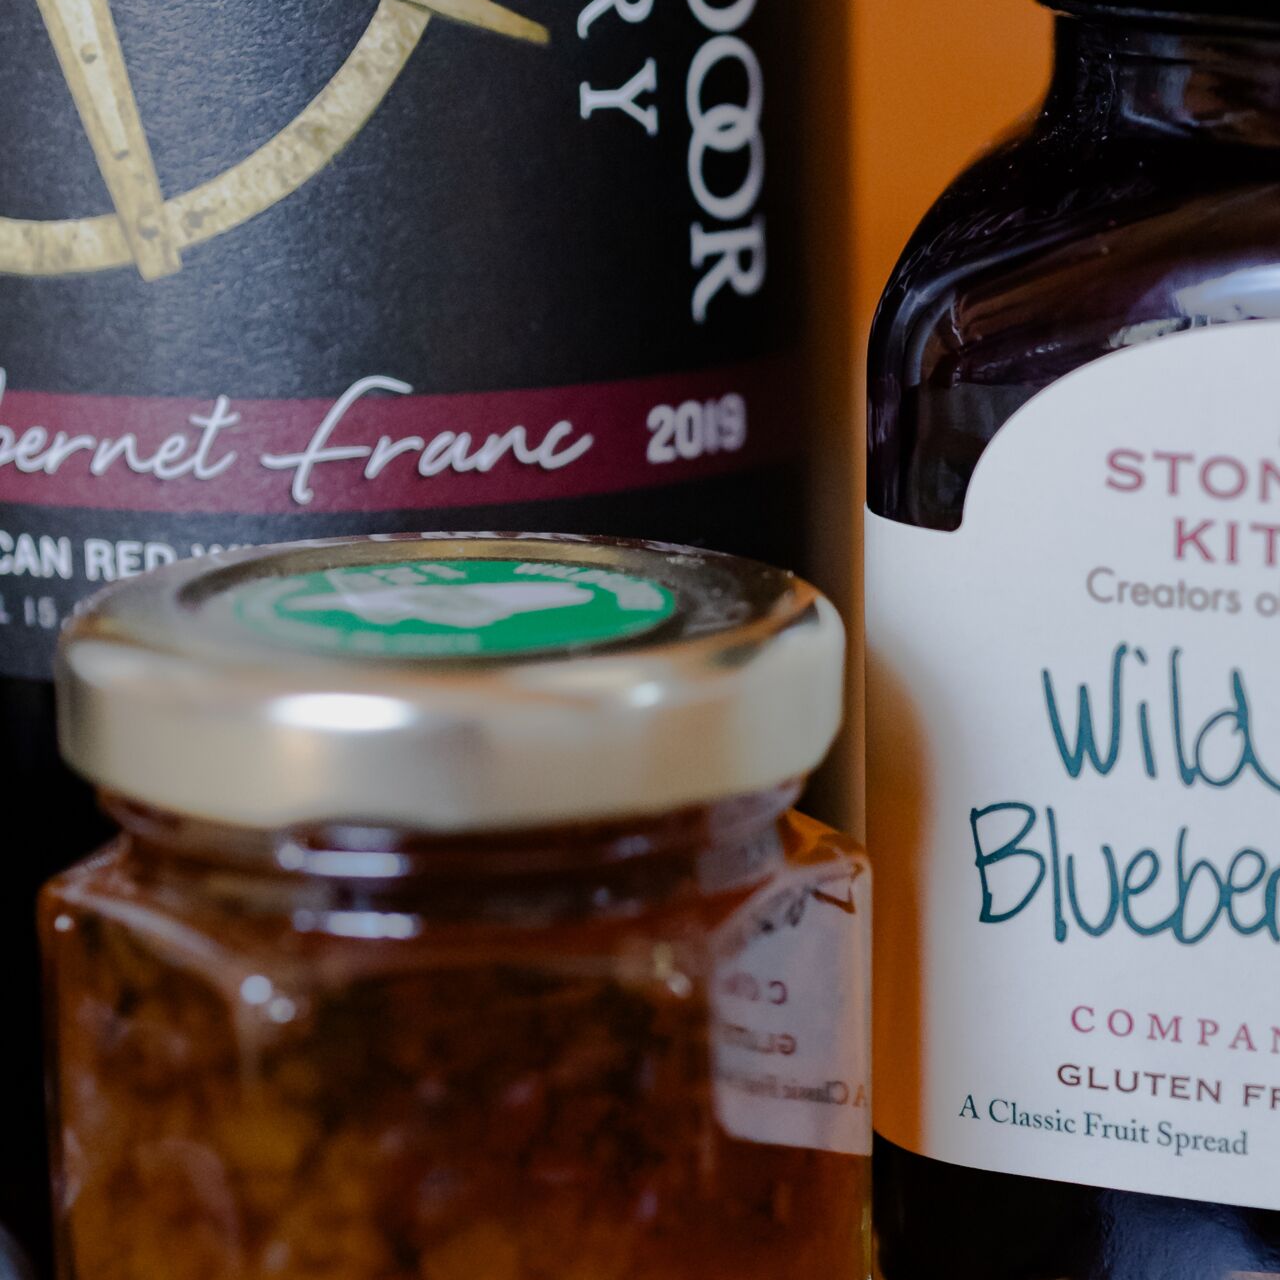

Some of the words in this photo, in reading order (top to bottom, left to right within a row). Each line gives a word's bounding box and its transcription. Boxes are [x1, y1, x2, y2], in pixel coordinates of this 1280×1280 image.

[645, 393, 748, 465] 2019
[1085, 566, 1242, 617] Creators
[1056, 1062, 1222, 1105] GLUTEN
[958, 1093, 981, 1120] A
[988, 1097, 1077, 1135] Classic
[1083, 1110, 1150, 1144] Fruit
[1156, 1121, 1249, 1157] Spread
